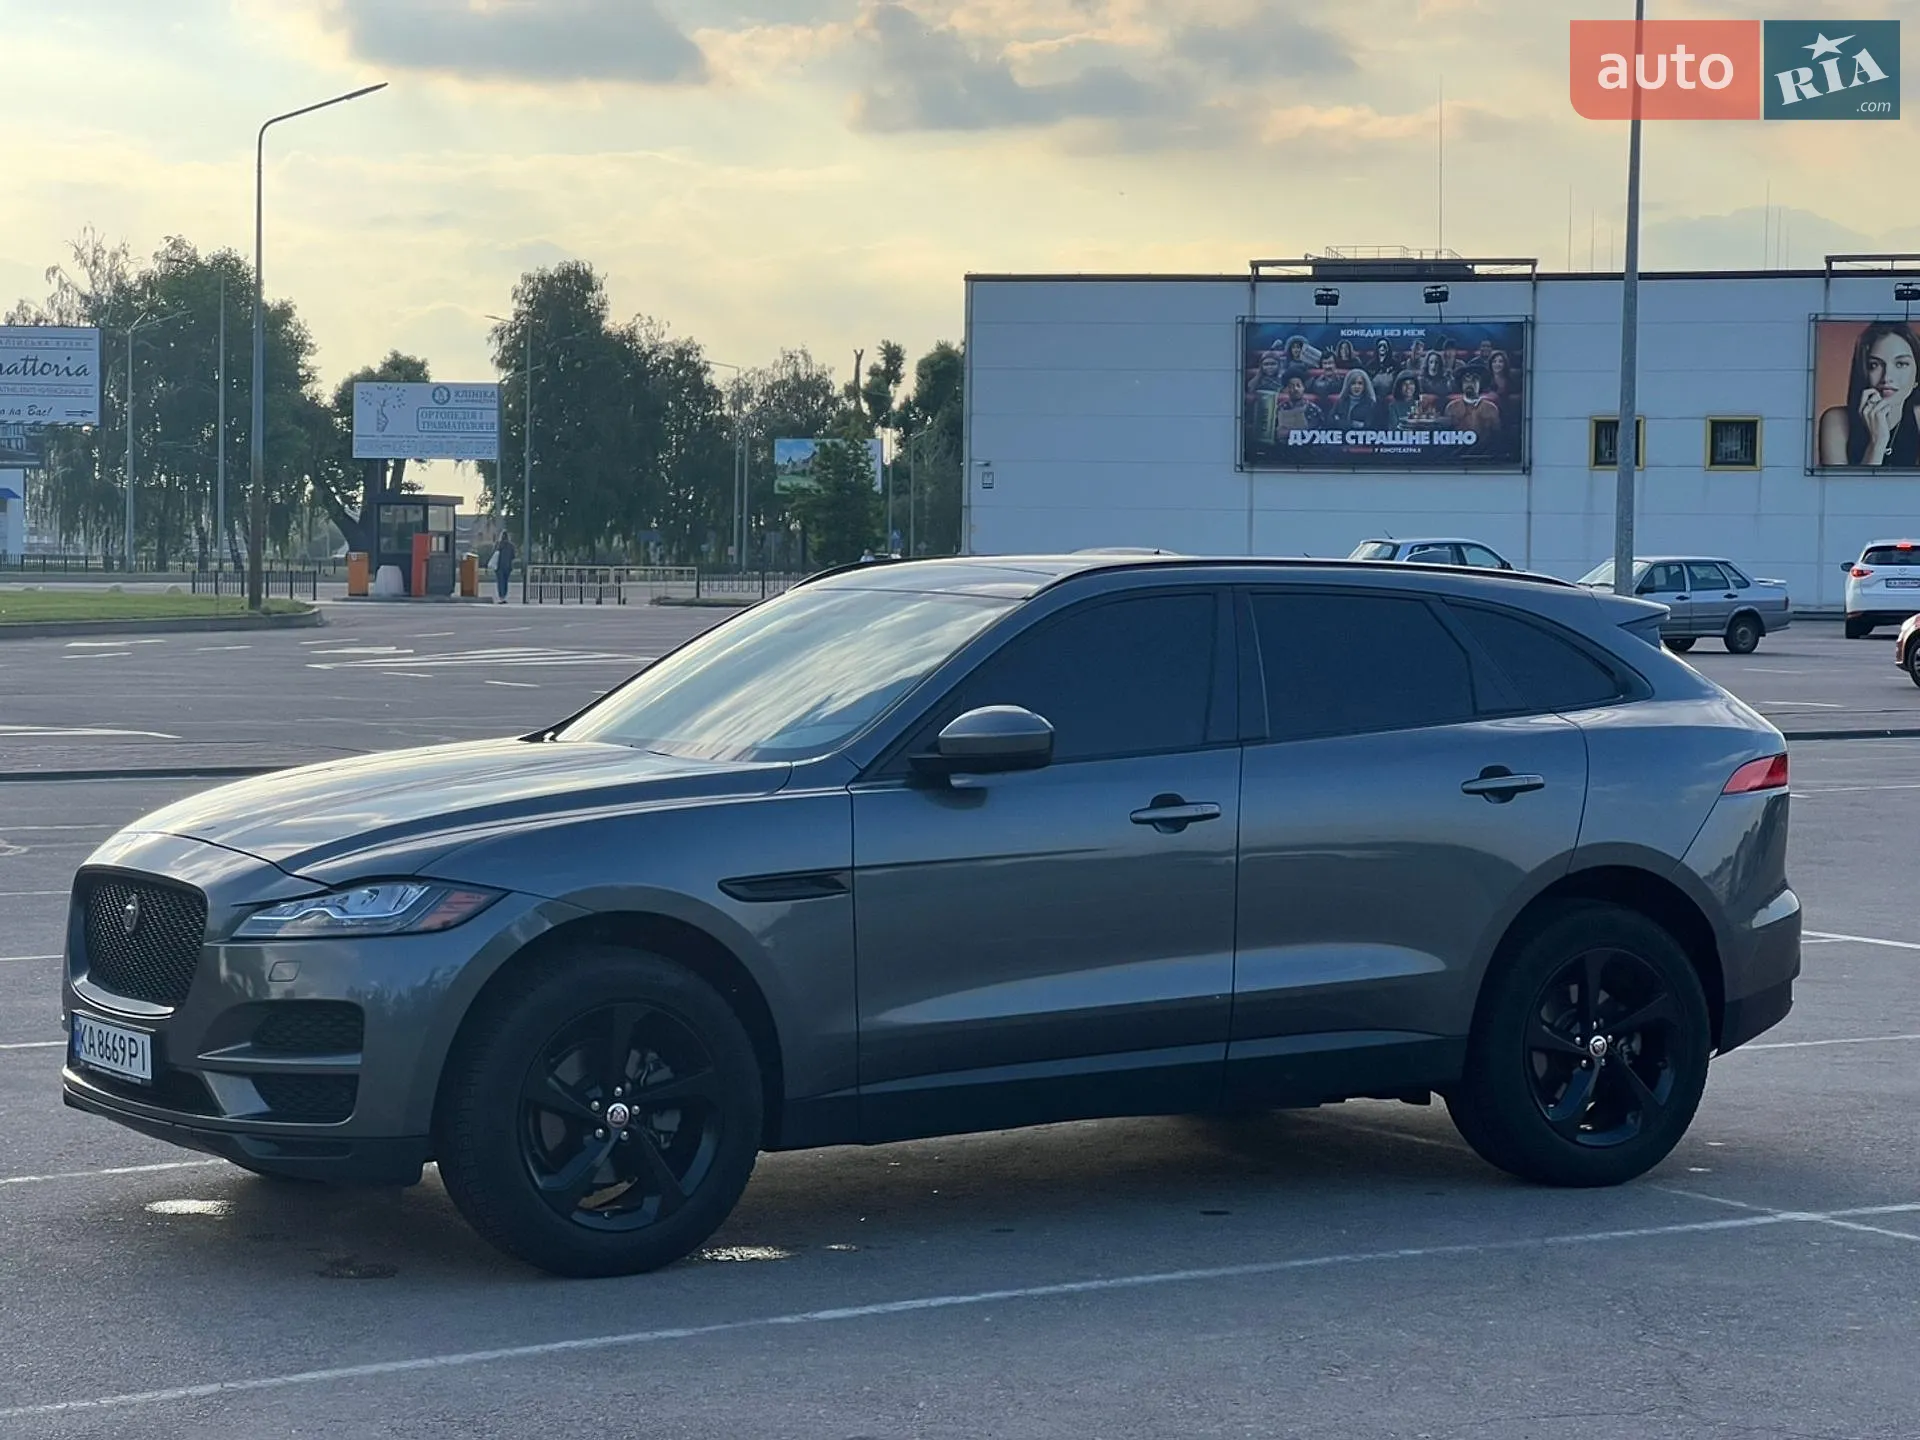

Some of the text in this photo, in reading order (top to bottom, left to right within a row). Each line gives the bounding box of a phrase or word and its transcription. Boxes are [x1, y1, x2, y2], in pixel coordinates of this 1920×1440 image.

[1288, 430, 1478, 446] ДУЖЕ СТРАШНЕ КІНО
